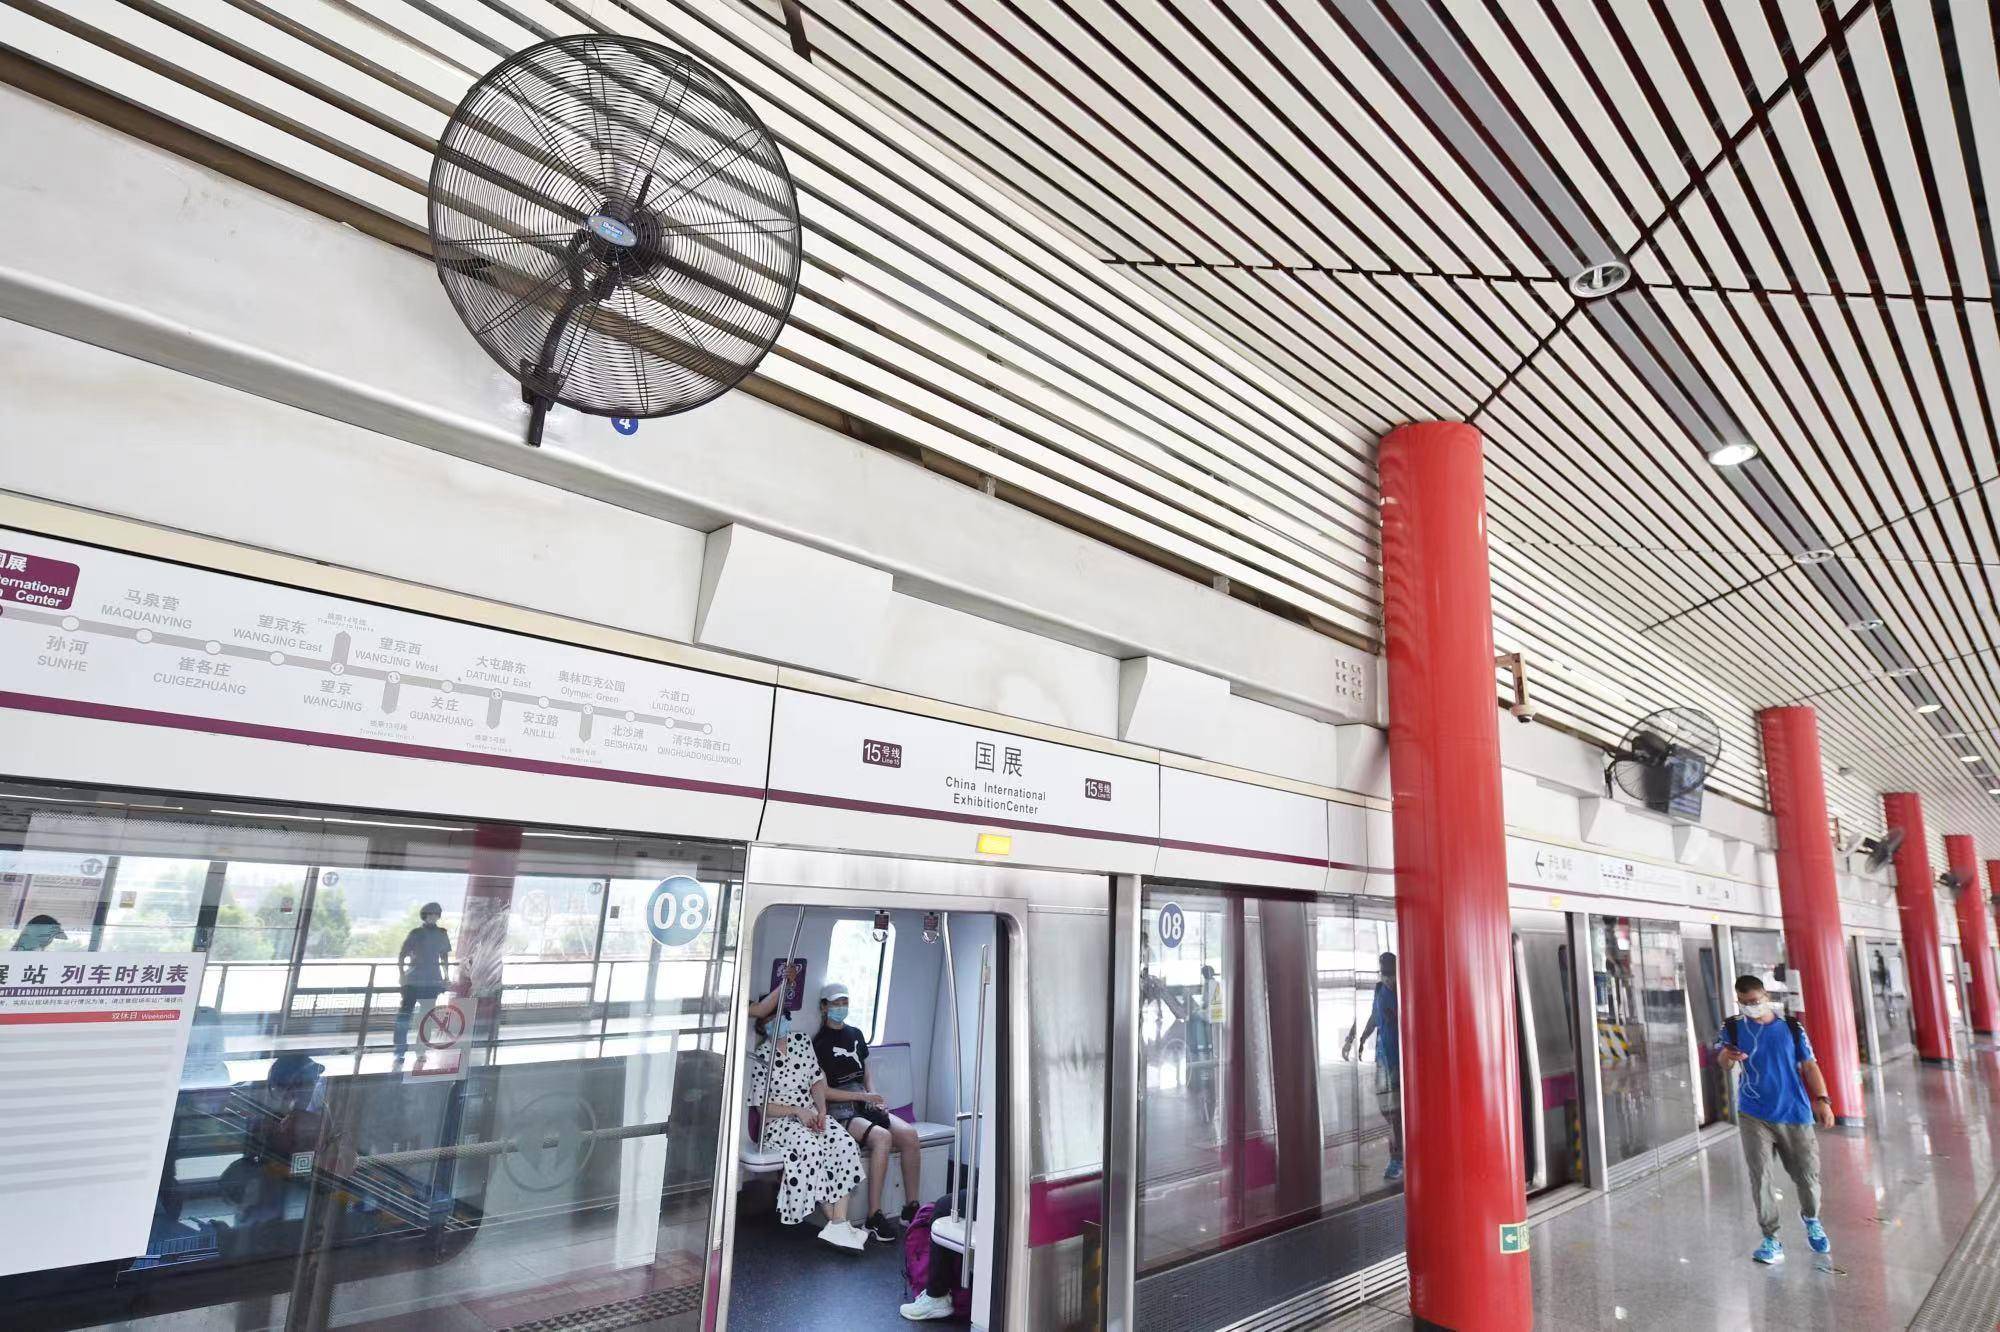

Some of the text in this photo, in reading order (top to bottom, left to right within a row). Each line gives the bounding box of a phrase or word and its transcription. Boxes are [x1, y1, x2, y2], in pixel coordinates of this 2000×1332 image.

[619, 417, 631, 430] 4
[0, 576, 70, 597] ernational
[15, 590, 62, 607] Center
[125, 588, 180, 612] 马泉营
[101, 604, 192, 629] MAQUANYING
[258, 614, 305, 635] 望京东
[46, 635, 89, 655] 孙河
[233, 628, 322, 652] WANGJING East
[379, 636, 422, 655] 望京西
[37, 655, 88, 672] SUNHE
[177, 656, 231, 678] 崔各庄
[355, 649, 438, 672] WANGJING West
[476, 655, 526, 674] 大屯路东
[153, 672, 247, 695] CUIGEZHUANG
[320, 679, 352, 695] 望京
[465, 669, 531, 688] DATUNLU East
[558, 669, 626, 693] 奥林匹克公园
[303, 694, 362, 712] WANGJING
[432, 696, 459, 711] 关庄
[560, 686, 619, 704] Olympic Green
[659, 688, 690, 702] 六道口
[651, 702, 696, 717] LIUDAOKOU
[409, 710, 474, 728] GUANZHUANG
[522, 711, 560, 728] 安立路
[523, 727, 555, 740] ANLILU
[612, 724, 645, 740] 北沙滩
[604, 739, 648, 752] BEISHATAN
[672, 734, 731, 752] 清华东路西口
[974, 741, 1023, 777] 国展
[945, 776, 1046, 801] China International
[654, 892, 703, 930] 08
[1162, 909, 1182, 934] 08
[61, 987, 88, 996] Center
[90, 986, 122, 995] STATION
[124, 985, 162, 995] TIMETABLE
[112, 1011, 138, 1021] 双休日
[141, 1012, 176, 1021] Weekends
